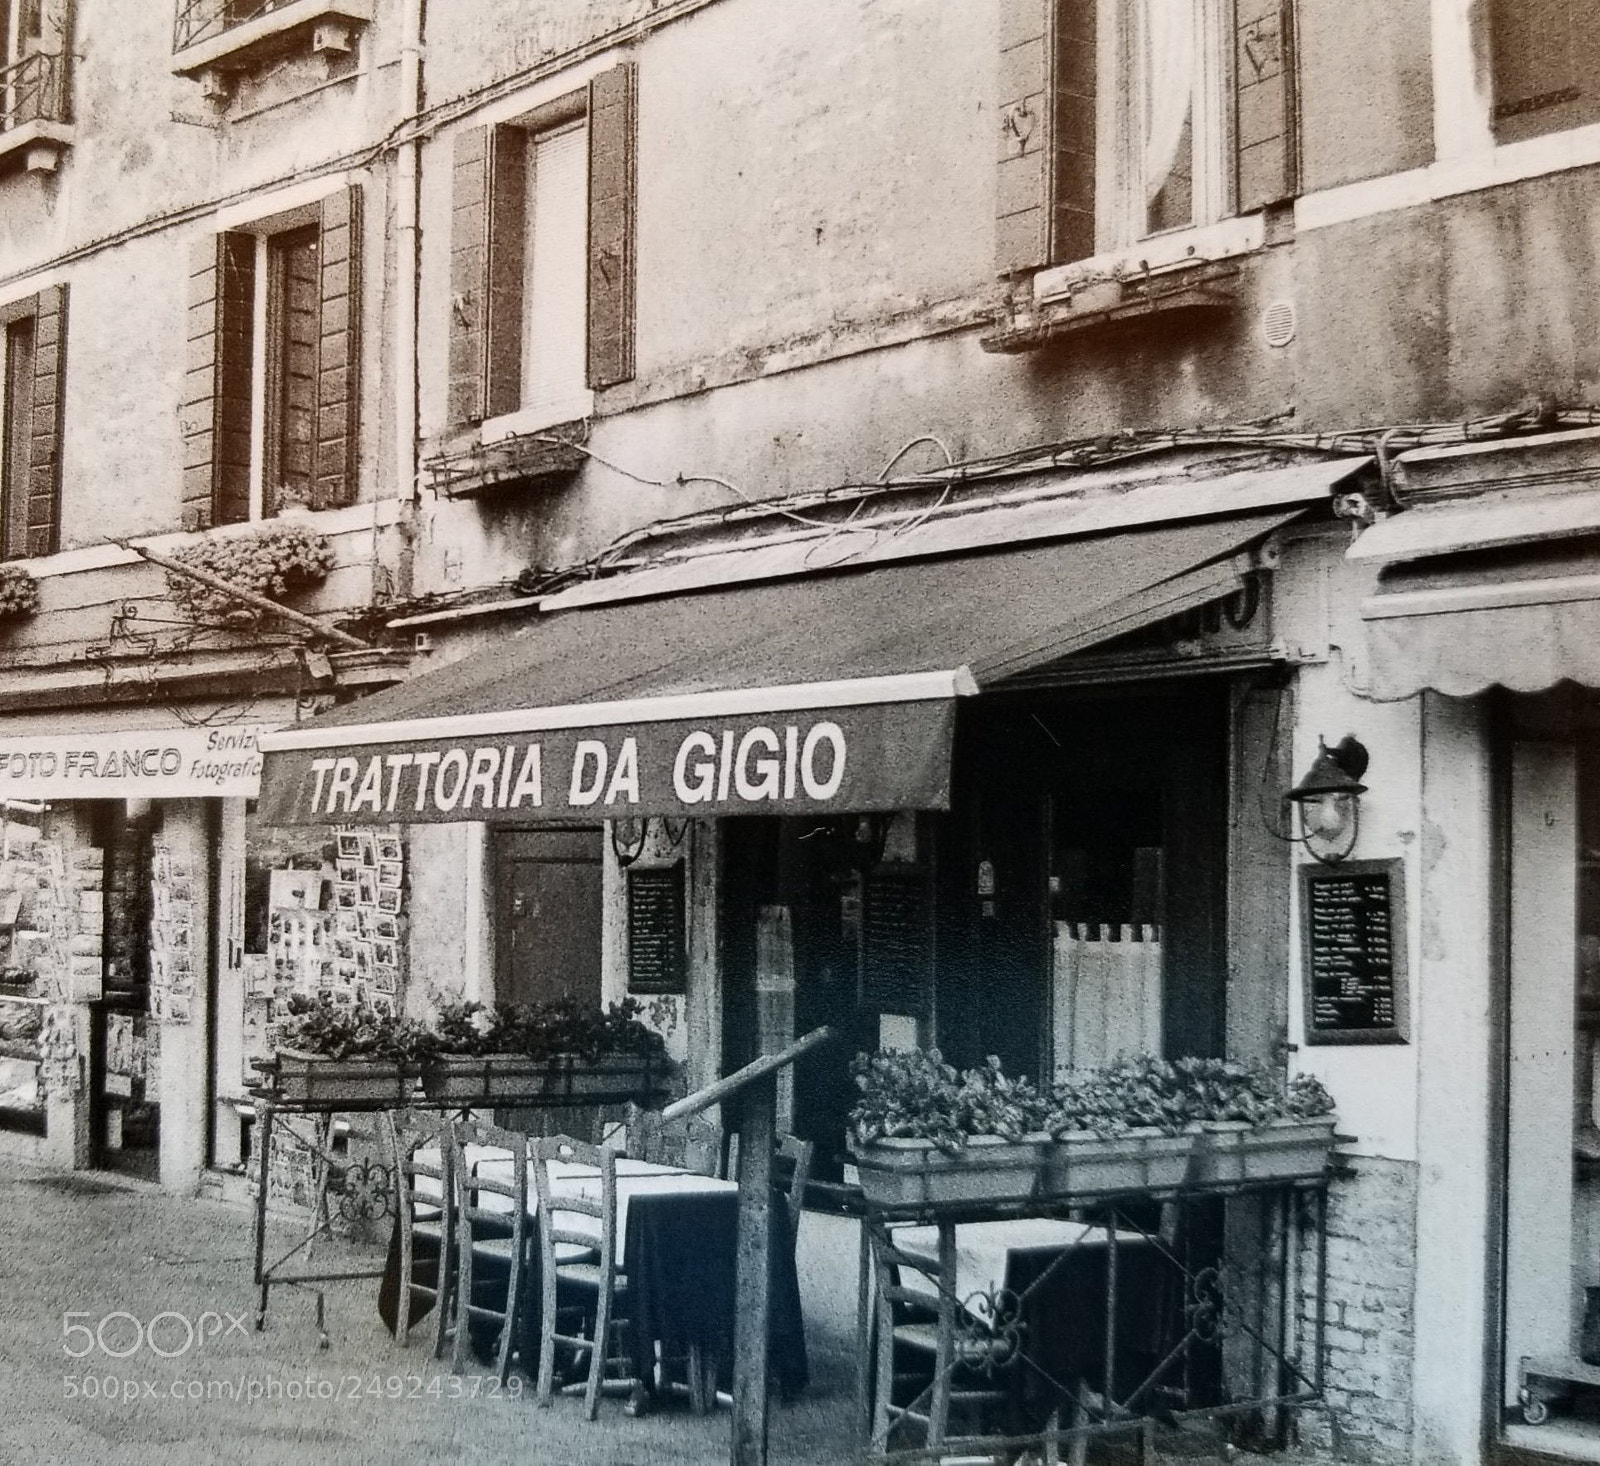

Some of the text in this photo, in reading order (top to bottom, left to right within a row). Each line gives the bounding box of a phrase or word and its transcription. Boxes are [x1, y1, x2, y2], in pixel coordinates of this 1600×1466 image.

[64, 748, 182, 778] FRANCO
[310, 721, 847, 815] TRATTORIA DA GIGIO
